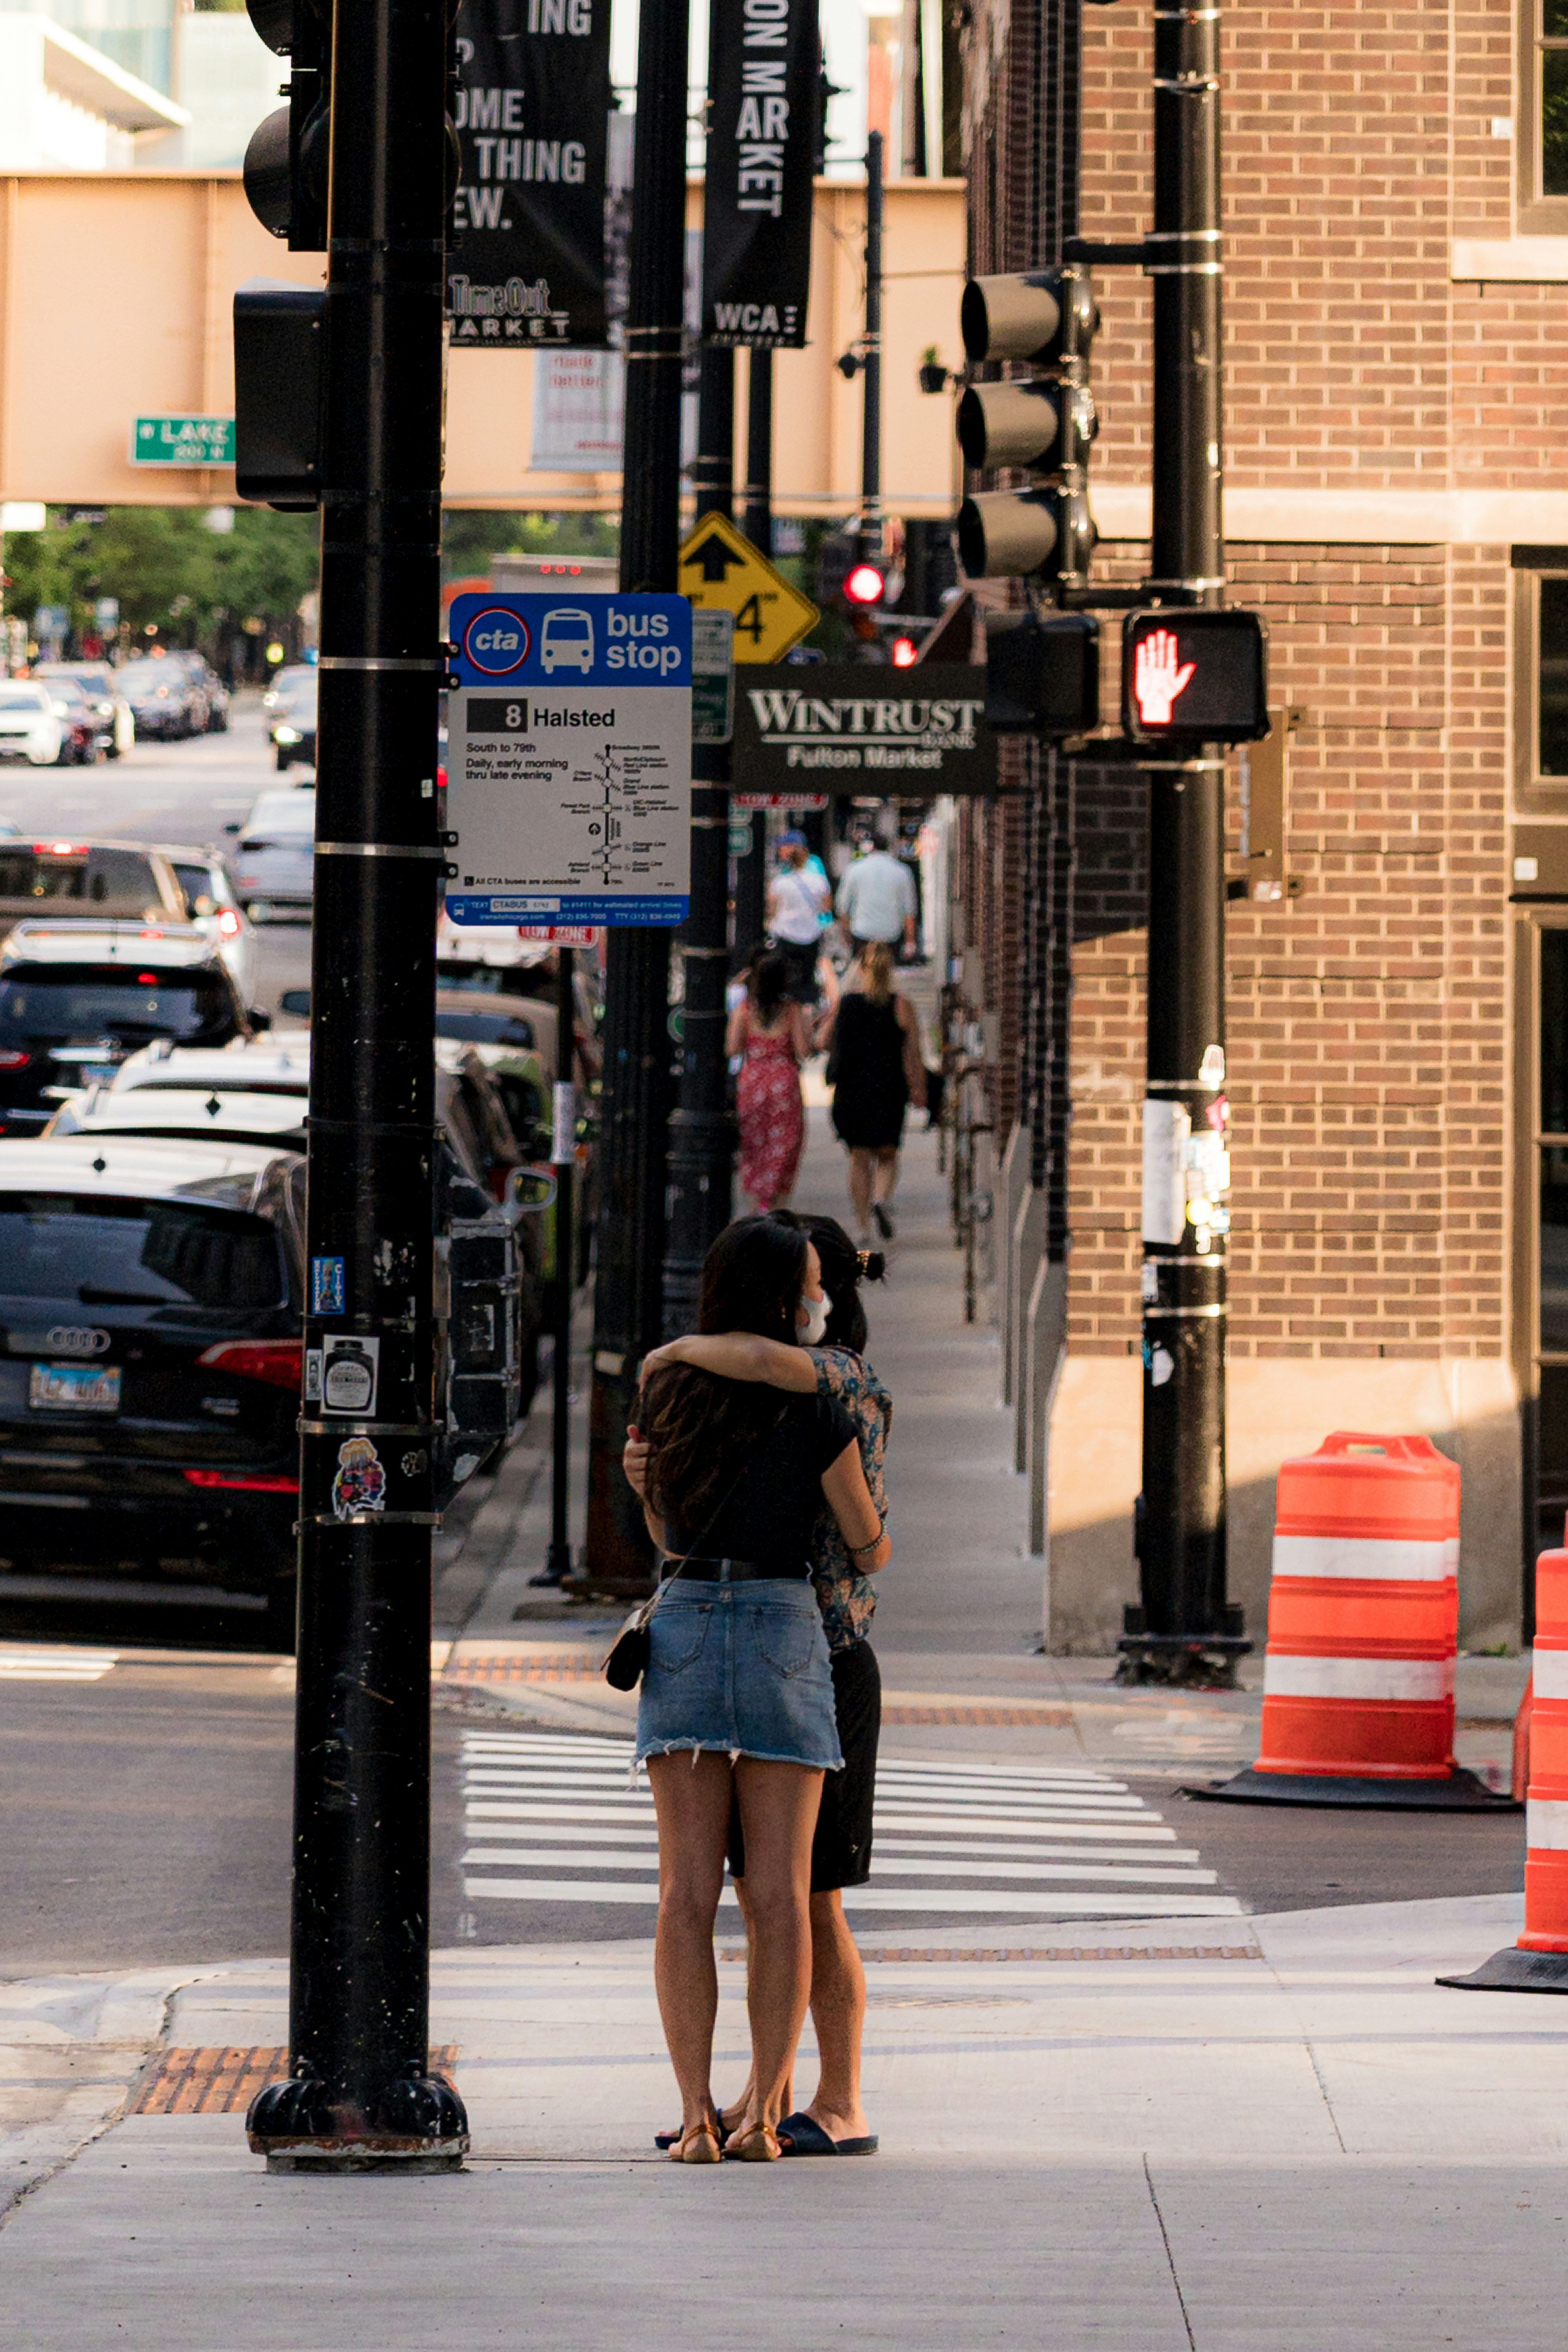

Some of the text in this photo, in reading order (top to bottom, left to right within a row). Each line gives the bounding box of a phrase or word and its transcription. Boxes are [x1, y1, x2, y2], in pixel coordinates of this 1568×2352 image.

[735, 61, 789, 216] MARKET
[474, 137, 586, 183] THING
[161, 421, 229, 444] LAKE
[607, 608, 669, 637] bus
[736, 594, 765, 643] 4
[475, 630, 519, 650] cta
[606, 641, 682, 677] stop
[506, 705, 615, 727] 8 Halsted
[466, 742, 536, 753] South to 79th
[788, 745, 943, 768] Fulton Market
[466, 770, 552, 782] thru late evening
[497, 759, 523, 770] early
[525, 759, 568, 770] morning
[492, 900, 528, 909] CTABUS
